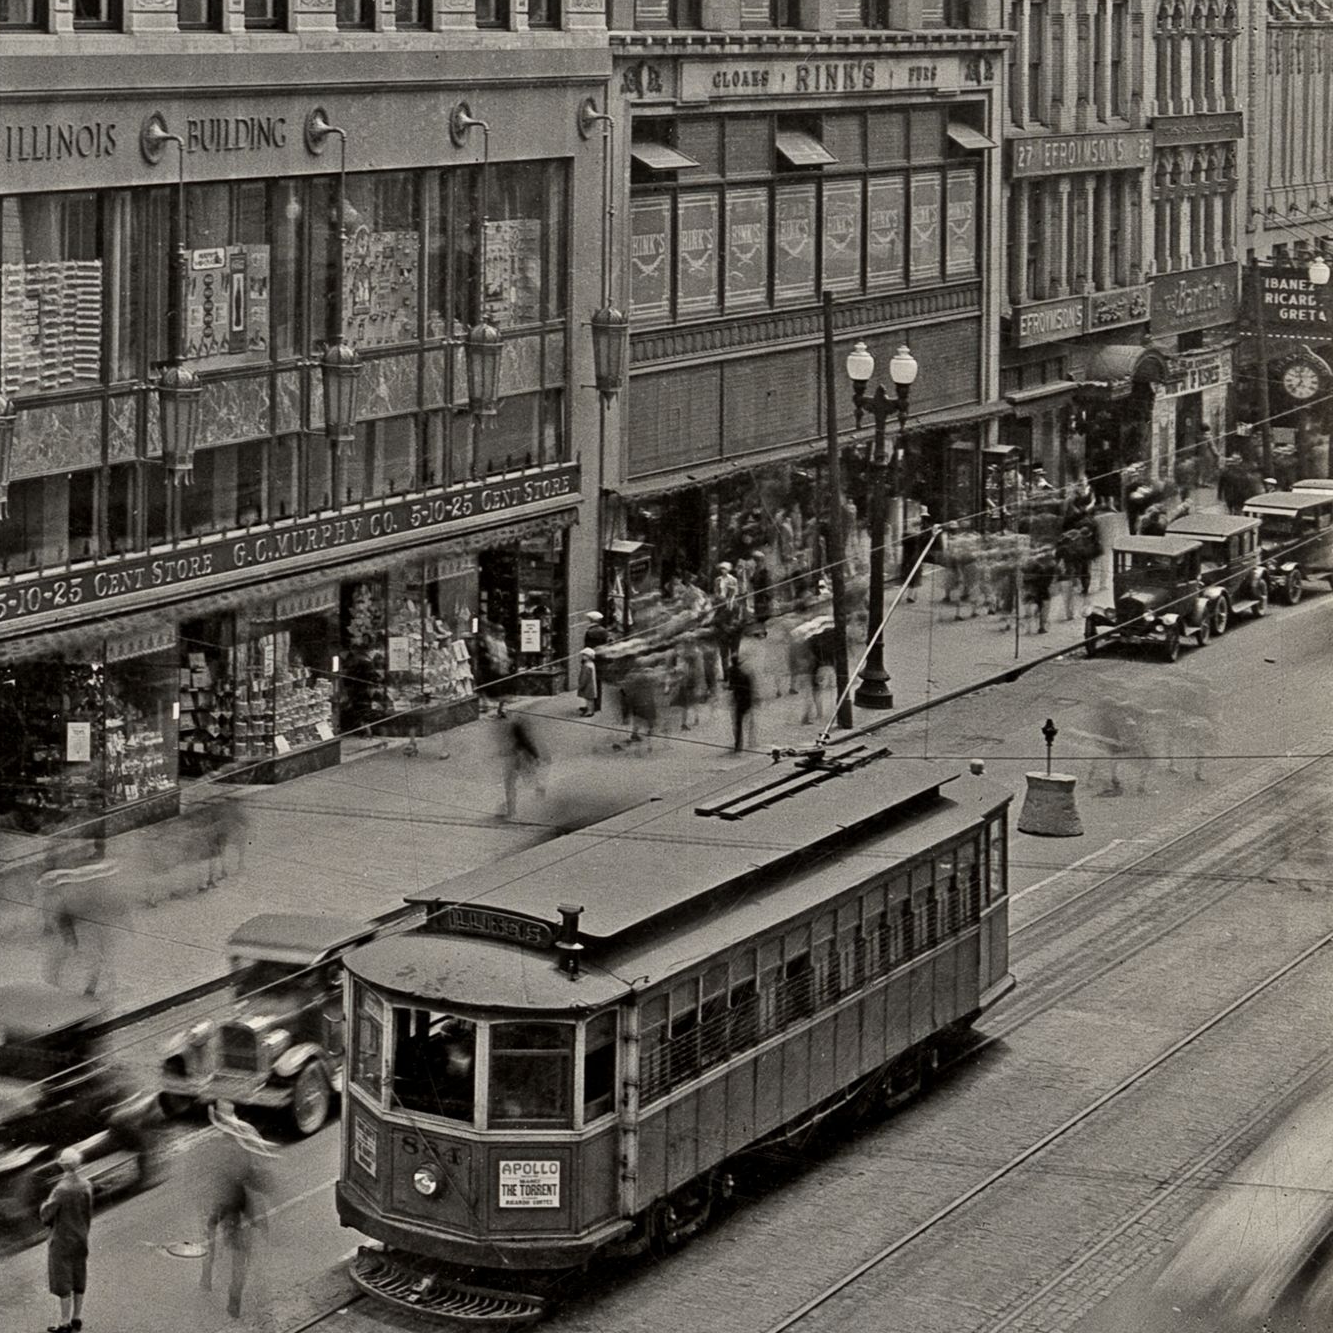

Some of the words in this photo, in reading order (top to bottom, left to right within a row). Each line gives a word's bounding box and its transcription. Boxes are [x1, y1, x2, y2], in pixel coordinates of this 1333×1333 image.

[795, 61, 876, 92] RINK'S
[5, 122, 117, 162] ILLINOIS
[186, 116, 287, 154] BUILDING
[1017, 145, 1032, 167] 27
[1264, 293, 1324, 307] RICARD
[94, 567, 146, 597] CENT
[151, 554, 213, 585] STORE
[369, 511, 398, 537] CO.
[410, 493, 474, 528] 5-10-25
[482, 486, 521, 512] CENT
[523, 475, 570, 503] STORE
[448, 909, 541, 943] ILLINOIS
[502, 1163, 558, 1175] APOLLO
[501, 1184, 517, 1196] THE
